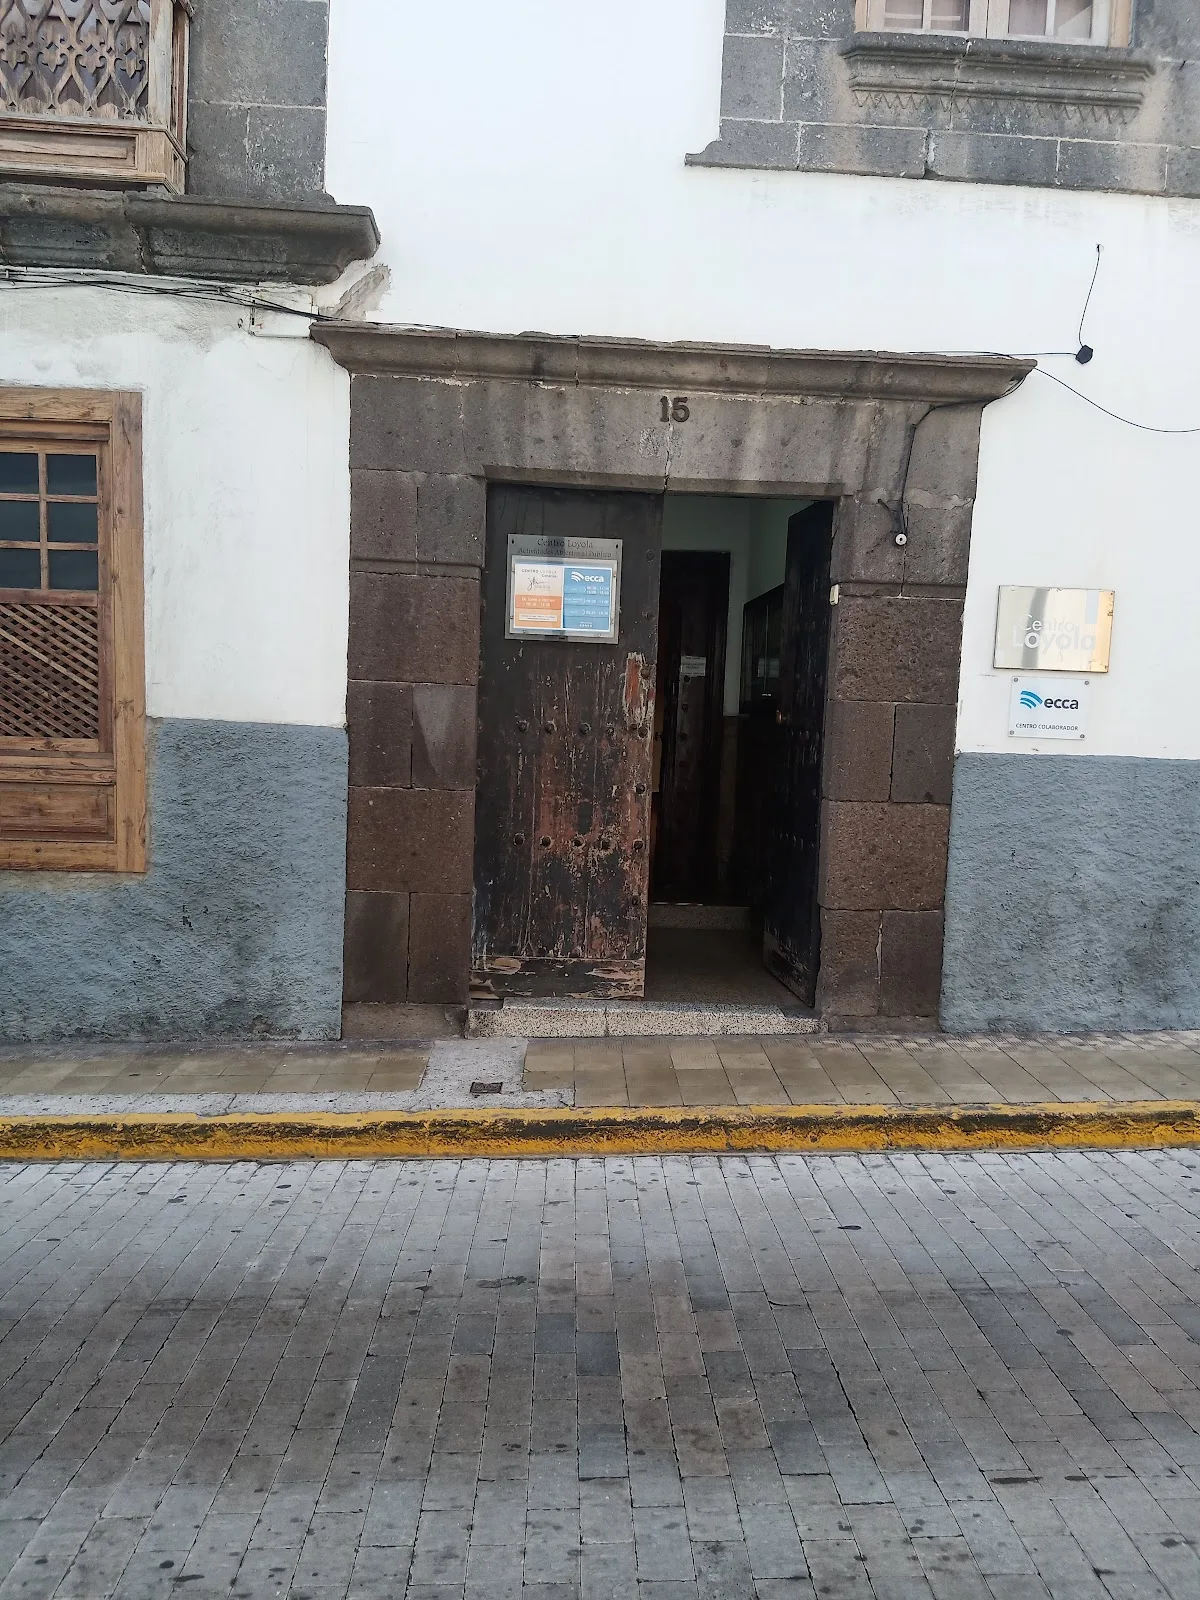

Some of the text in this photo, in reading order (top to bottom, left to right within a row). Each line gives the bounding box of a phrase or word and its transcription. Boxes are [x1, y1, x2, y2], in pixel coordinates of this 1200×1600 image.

[660, 396, 690, 422] 15
[537, 538, 593, 550] Centro Loyola
[584, 575, 604, 583] ecca
[1012, 613, 1096, 654] Centro Loyola
[1043, 697, 1079, 710] ecca
[1015, 722, 1079, 731] CENTRO COLABORADOR
